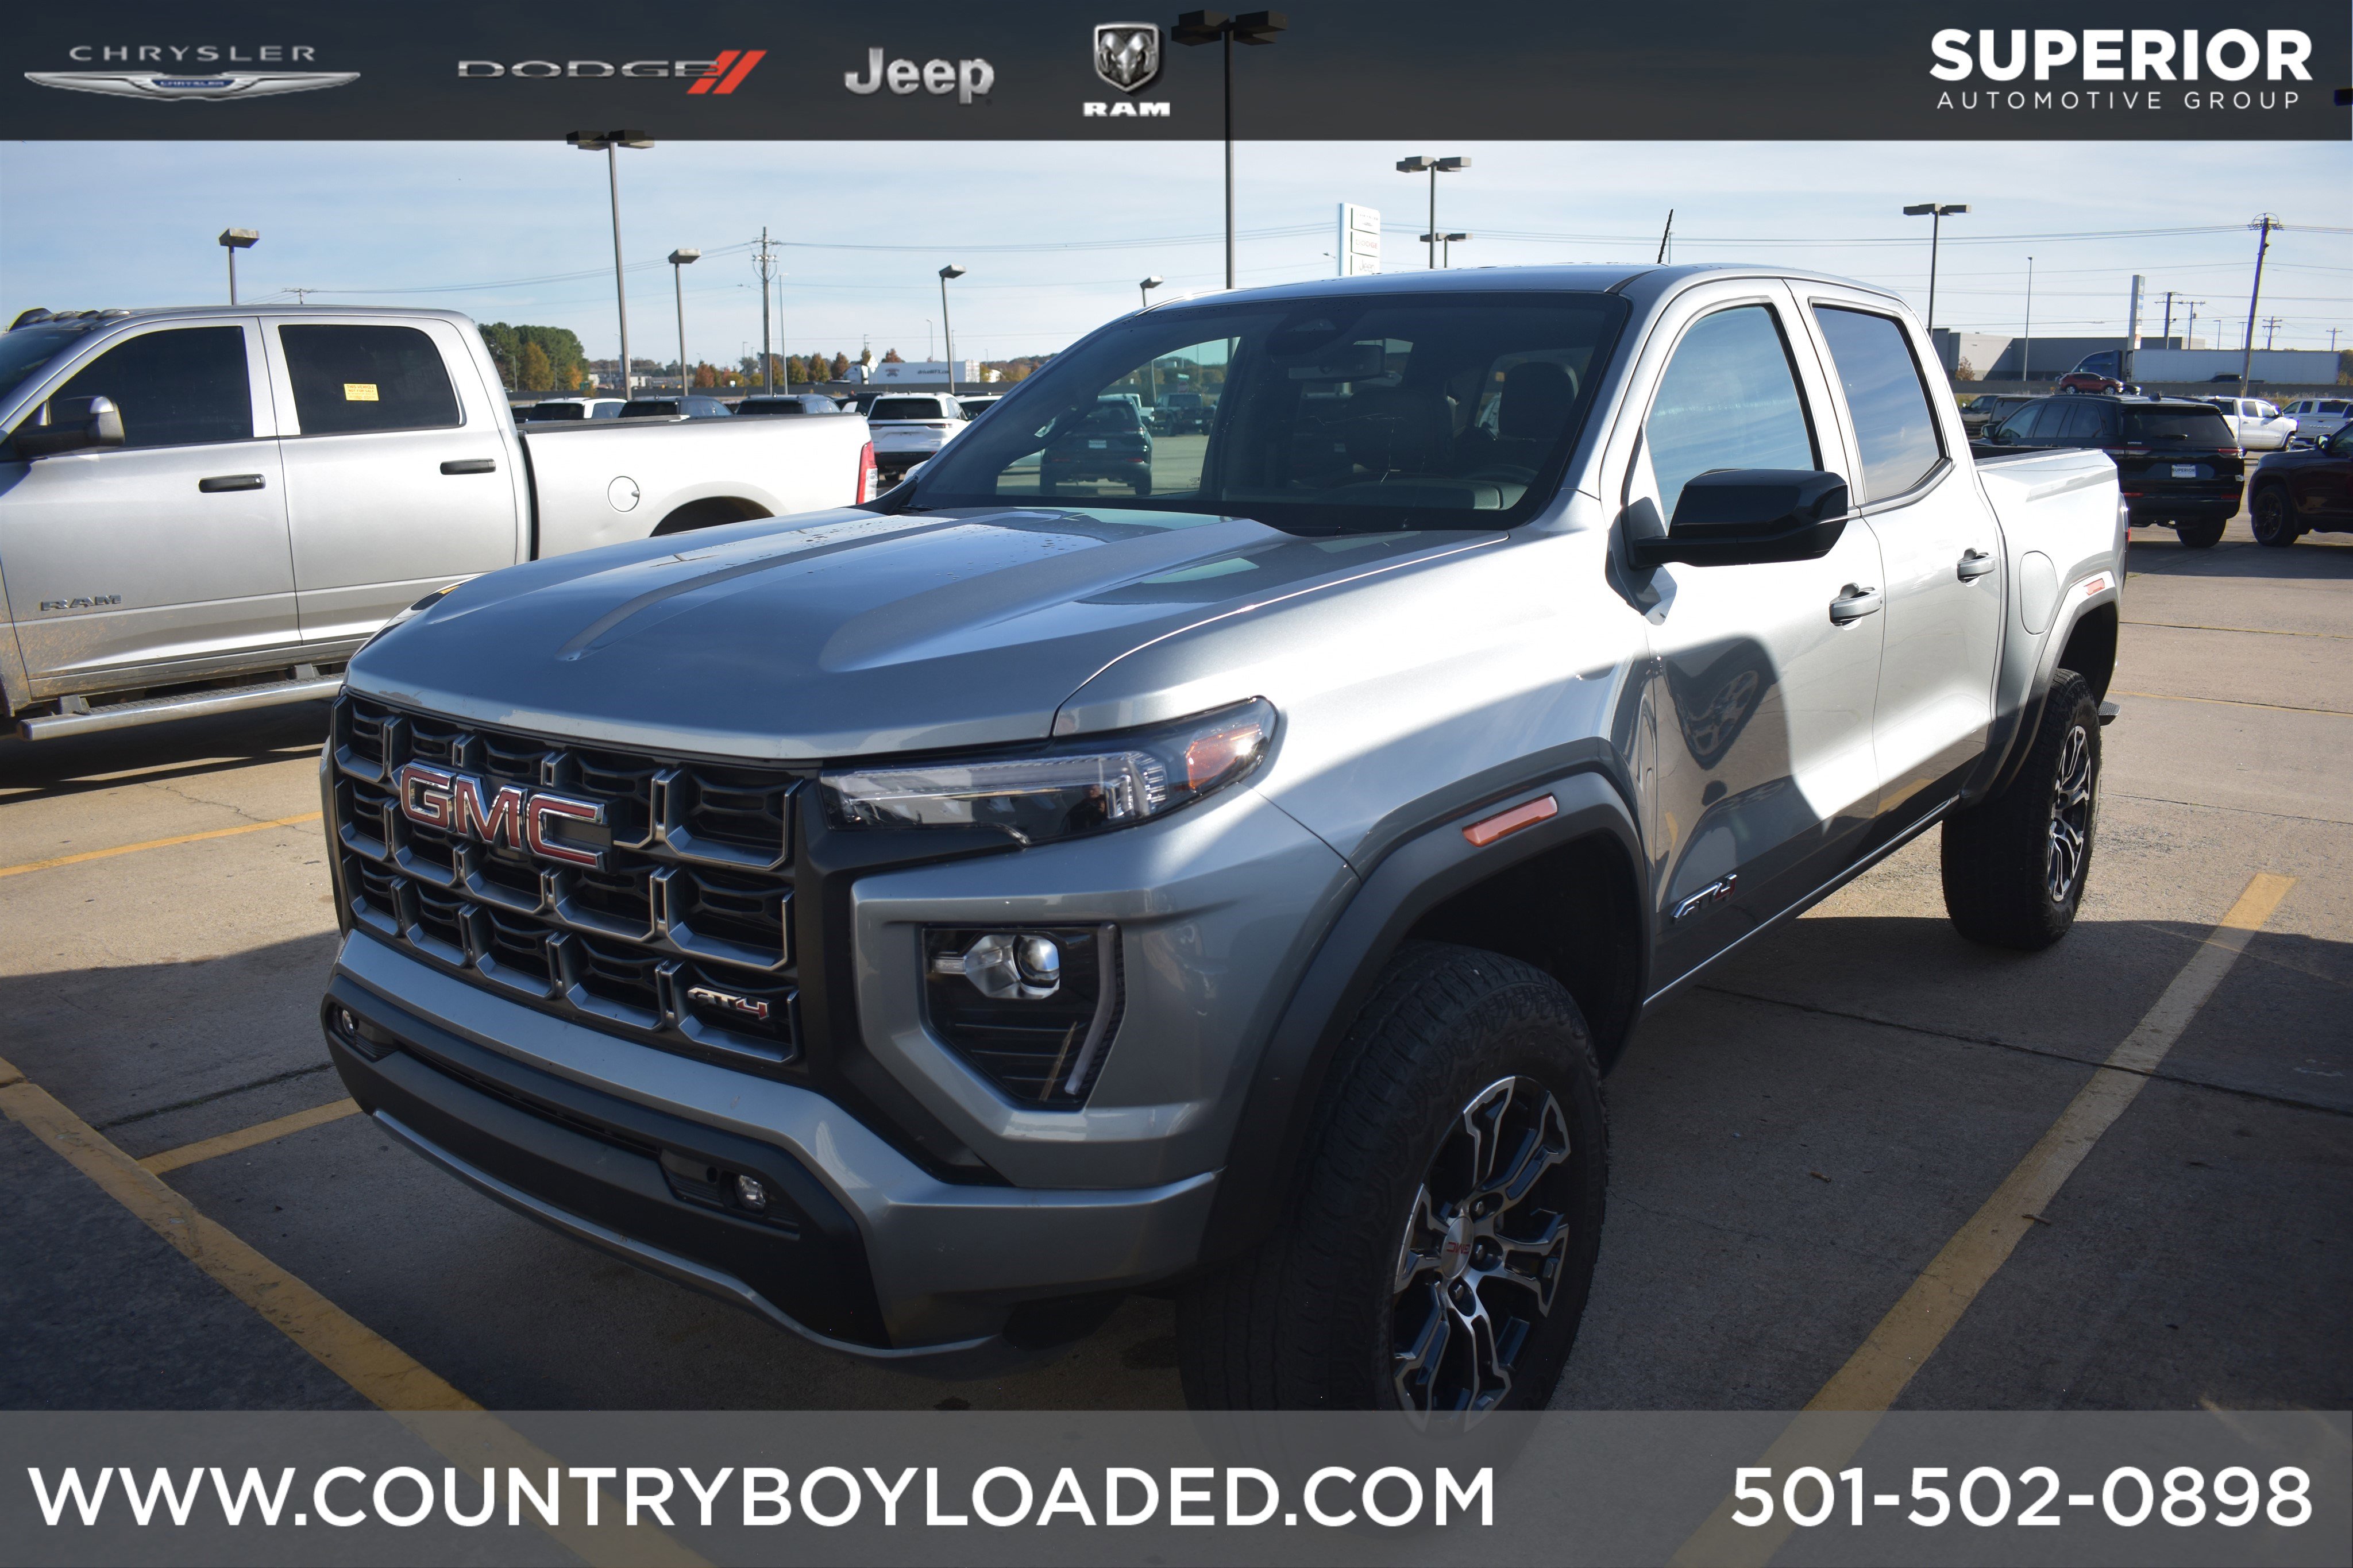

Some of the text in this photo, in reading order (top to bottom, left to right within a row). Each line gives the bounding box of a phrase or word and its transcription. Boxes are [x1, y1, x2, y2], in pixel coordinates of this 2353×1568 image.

[1355, 238, 1378, 249] DODGE
[40, 593, 122, 612] RAM
[402, 759, 608, 871] GMC
[688, 987, 770, 1020] AT4
[1446, 1241, 1471, 1256] GMC
